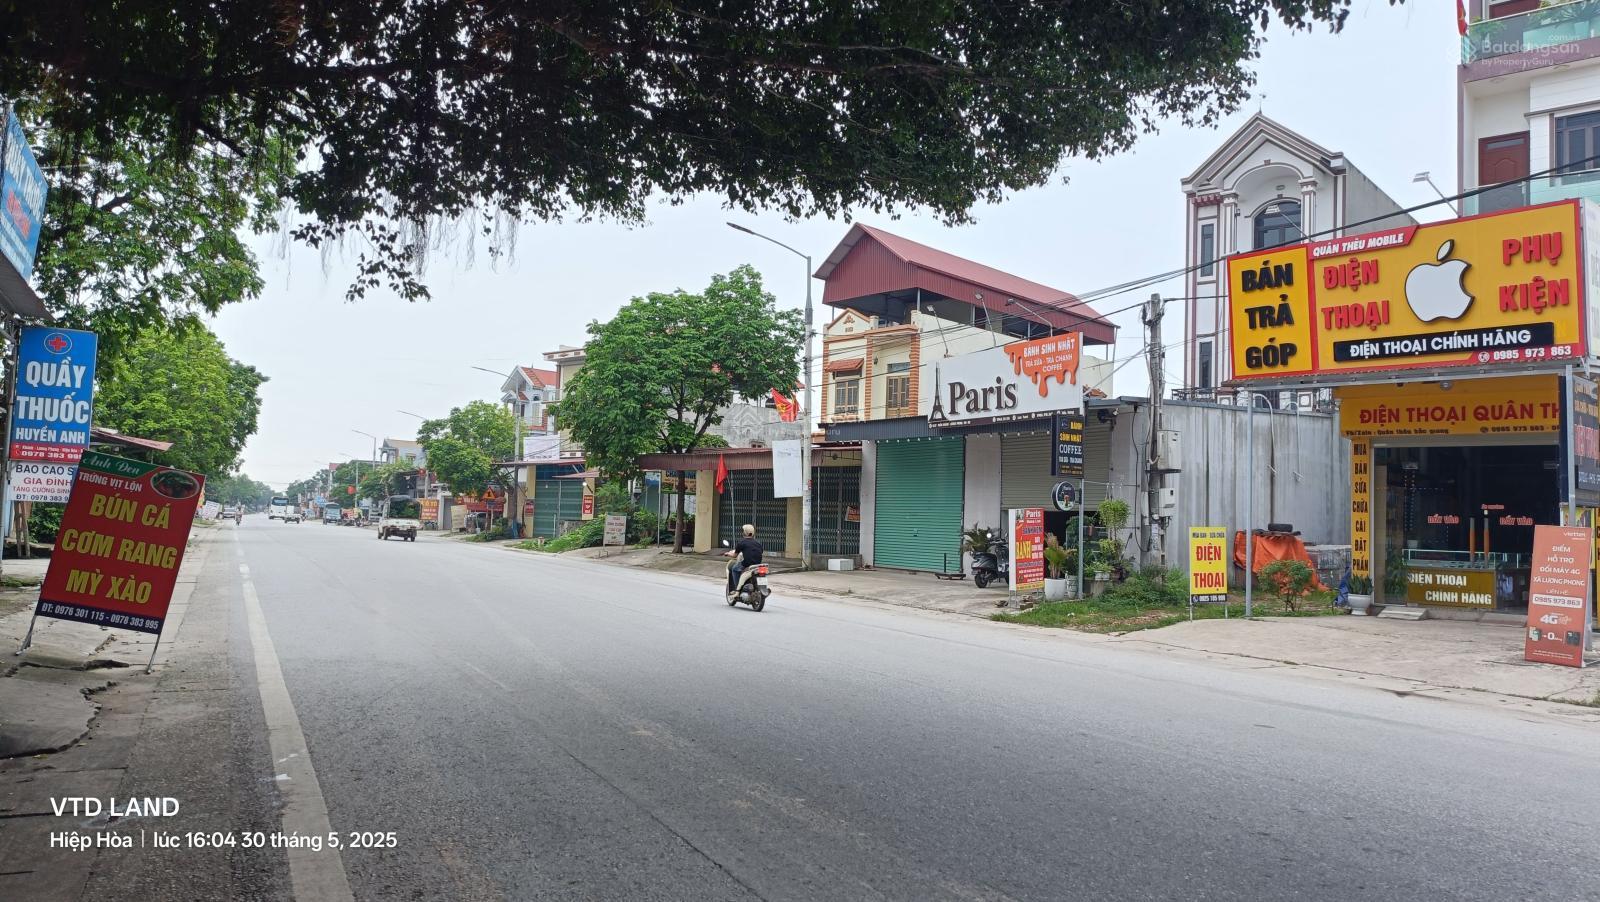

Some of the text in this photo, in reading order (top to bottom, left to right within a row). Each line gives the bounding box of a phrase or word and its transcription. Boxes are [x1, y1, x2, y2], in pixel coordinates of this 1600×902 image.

[1312, 242, 1340, 257] QUÂN
[1367, 232, 1404, 249] MOBILE
[1502, 231, 1562, 266] PHỤ
[1241, 259, 1294, 293] BÁN
[1322, 257, 1379, 291] ĐIỆN
[1498, 276, 1570, 314] KIỆN
[1245, 293, 1295, 330] TRẢ
[1321, 299, 1390, 332] THOẠI
[1041, 342, 1056, 355] SINH
[1245, 336, 1298, 369] GÓP
[1349, 338, 1380, 360] ĐIỆN
[1382, 336, 1427, 356] THOẠI
[1431, 331, 1480, 352] CHÍNH
[1493, 345, 1572, 361] 0985 973 863
[25, 356, 87, 390] QUẦY
[1042, 363, 1063, 373] COFFEE
[948, 375, 1018, 415] Paris
[17, 392, 89, 425] THUỐC
[1359, 403, 1400, 427] ĐIỆN
[1406, 405, 1467, 425] THOẠI
[1473, 400, 1534, 421] QUÂN
[1540, 403, 1560, 419] TH
[15, 424, 86, 445] HUYỀN ANH
[1059, 444, 1083, 455] COFFEE
[1354, 443, 1367, 455] MUA
[16, 464, 75, 476] BAO CAO S
[1354, 460, 1367, 474] BÁN
[24, 477, 42, 485] GIA
[110, 478, 123, 490] VỊT
[1354, 477, 1367, 493] SỬA
[89, 492, 170, 529] BÚN CÁ
[1025, 510, 1041, 518] Paris
[1355, 517, 1366, 532] CÀI
[61, 529, 178, 569] CƠM RANG
[1196, 542, 1222, 565] ĐIỆN
[1435, 574, 1467, 588] THOẠI
[1553, 566, 1570, 574] MÁY
[65, 568, 152, 604] MỲ XÀO
[1193, 572, 1225, 592] THOẠI
[1553, 597, 1566, 605] 973
[1566, 598, 1581, 606] 863
[41, 604, 53, 613] ĐT:
[75, 608, 90, 618] 301
[91, 611, 105, 621] 115
[110, 613, 129, 625] 0978
[129, 616, 144, 627] 383
[145, 619, 159, 630] 995
[1540, 614, 1558, 625] 4G
